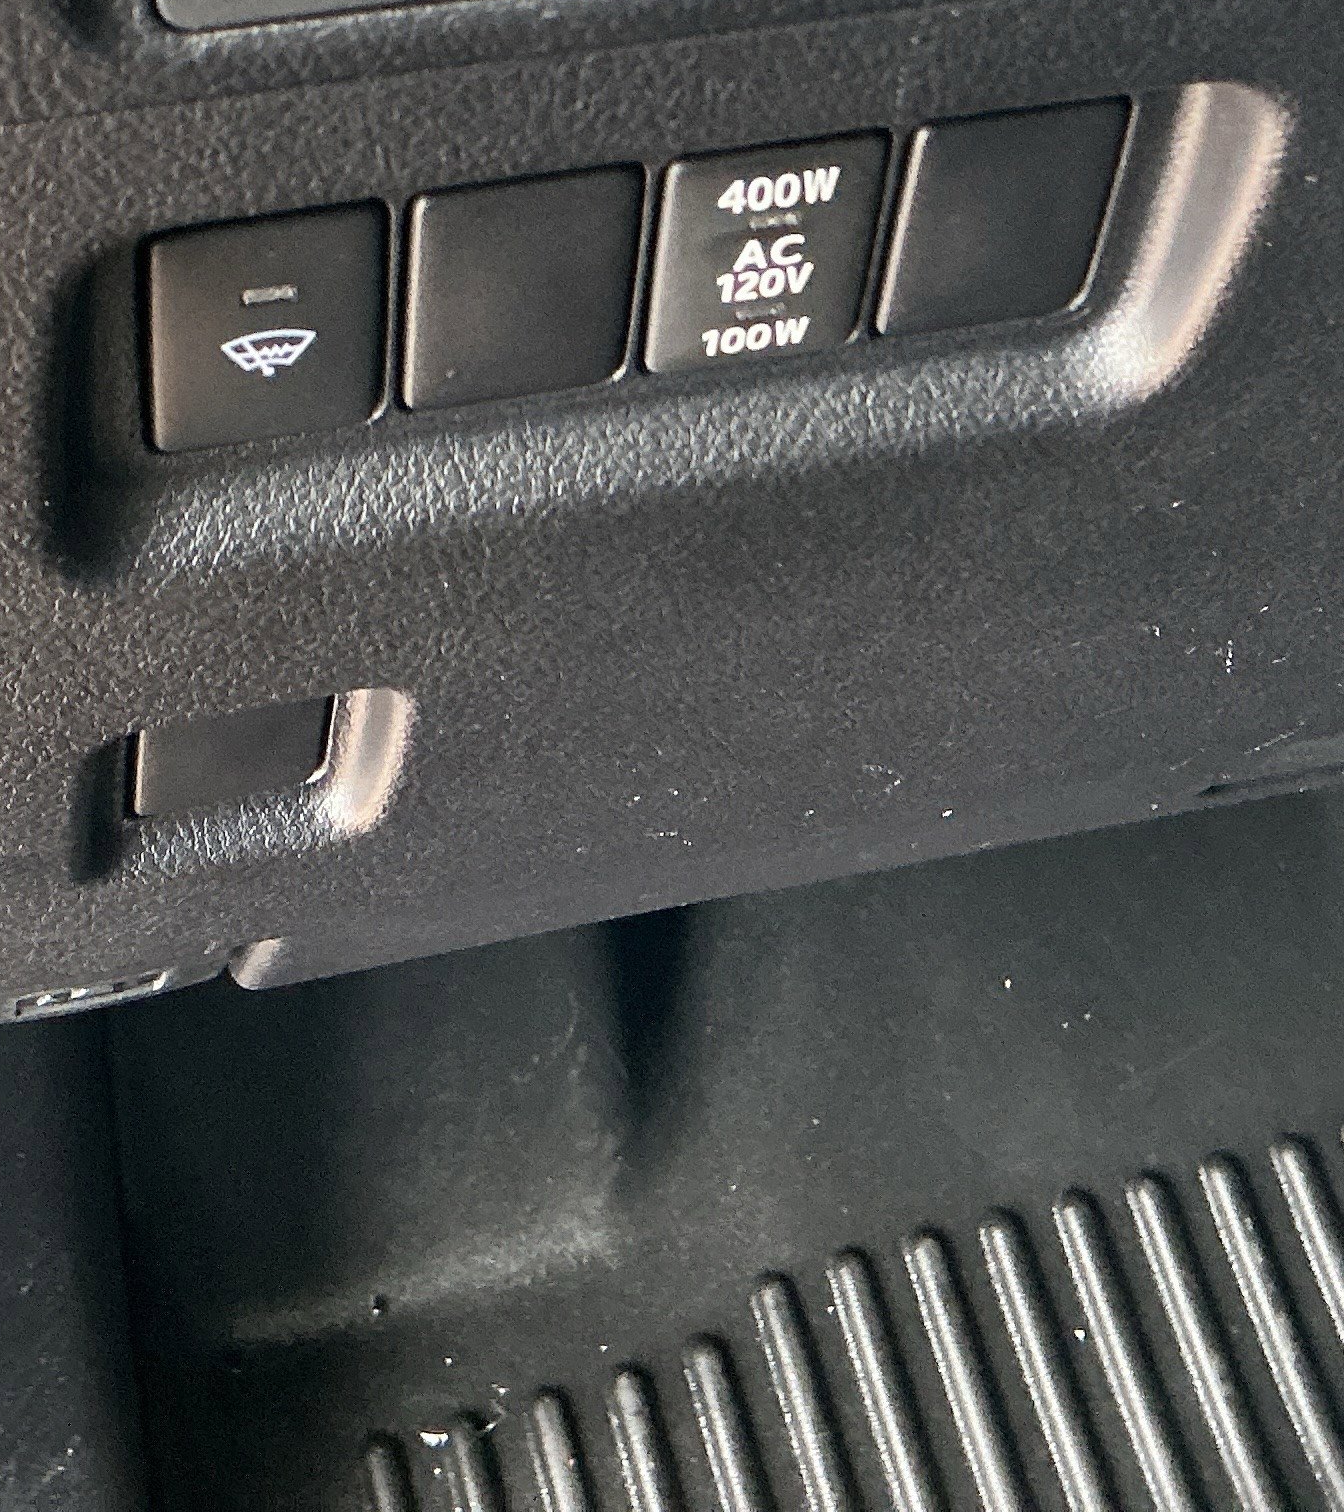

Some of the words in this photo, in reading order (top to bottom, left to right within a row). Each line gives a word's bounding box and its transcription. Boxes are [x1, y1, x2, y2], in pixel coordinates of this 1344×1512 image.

[717, 165, 841, 215] 400W
[732, 233, 806, 272] AC
[716, 261, 815, 303] 120V
[701, 315, 811, 357] 100W
